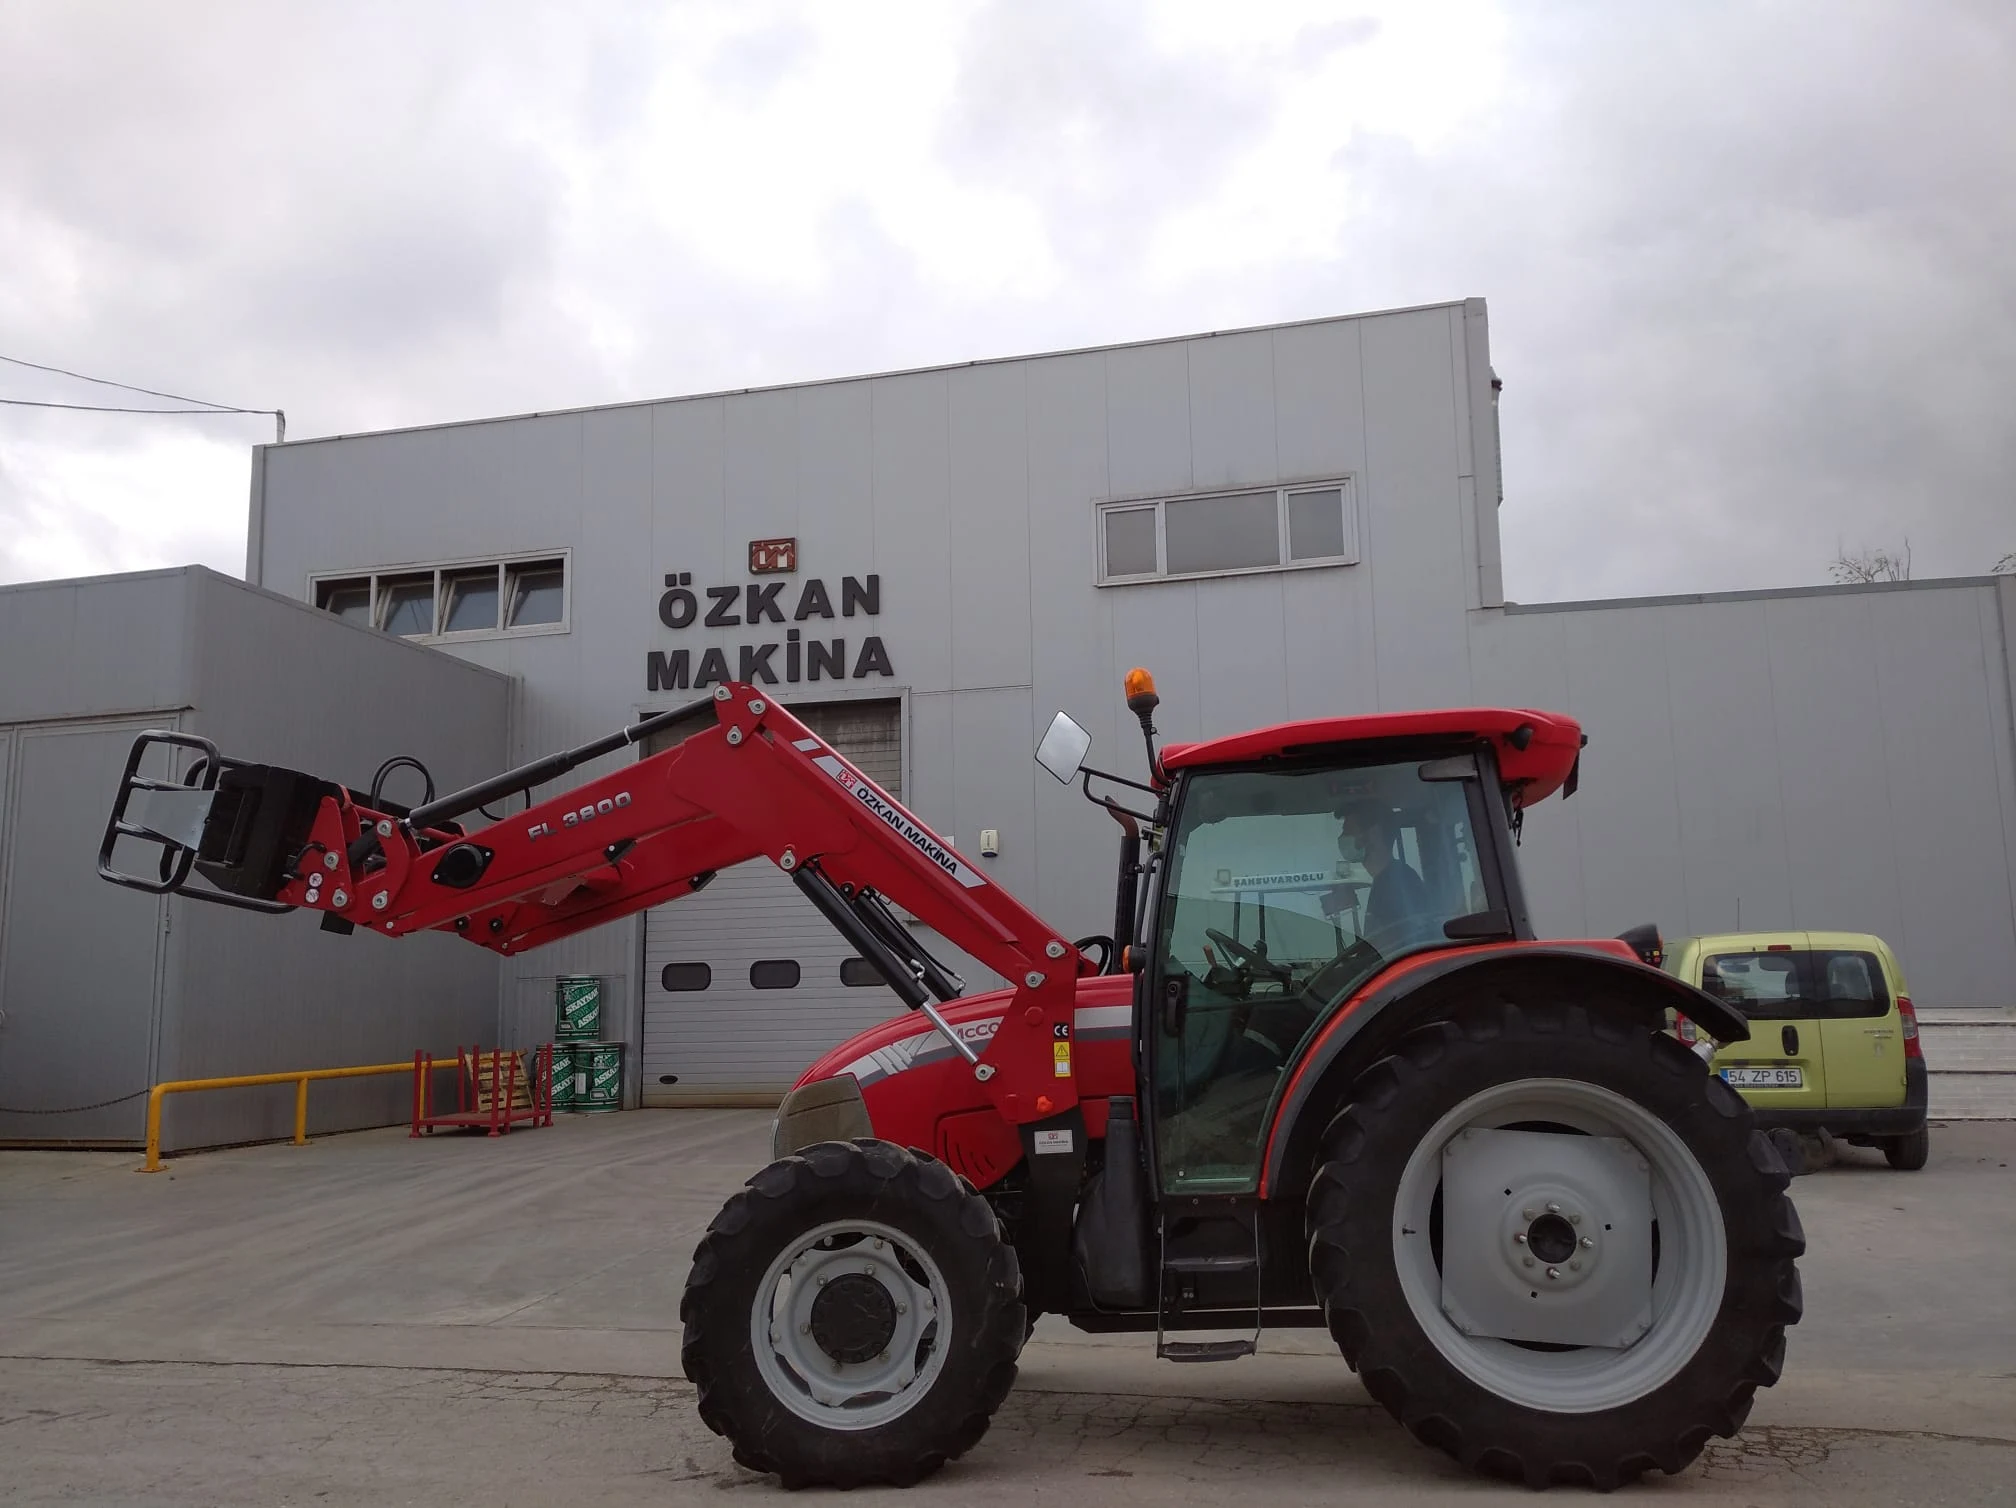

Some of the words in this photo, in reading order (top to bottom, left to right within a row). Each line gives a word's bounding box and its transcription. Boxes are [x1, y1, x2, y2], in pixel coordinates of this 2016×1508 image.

[658, 572, 879, 628] ÖZKAN
[647, 628, 894, 691] MAKİNA
[527, 822, 557, 842] FL
[562, 791, 632, 828] 3800
[856, 787, 904, 830] ÖZKAN
[903, 826, 957, 875] MAKİNA
[1729, 1071, 1746, 1083] 54
[1751, 1070, 1771, 1083] ZP
[1776, 1070, 1798, 1083] 615
